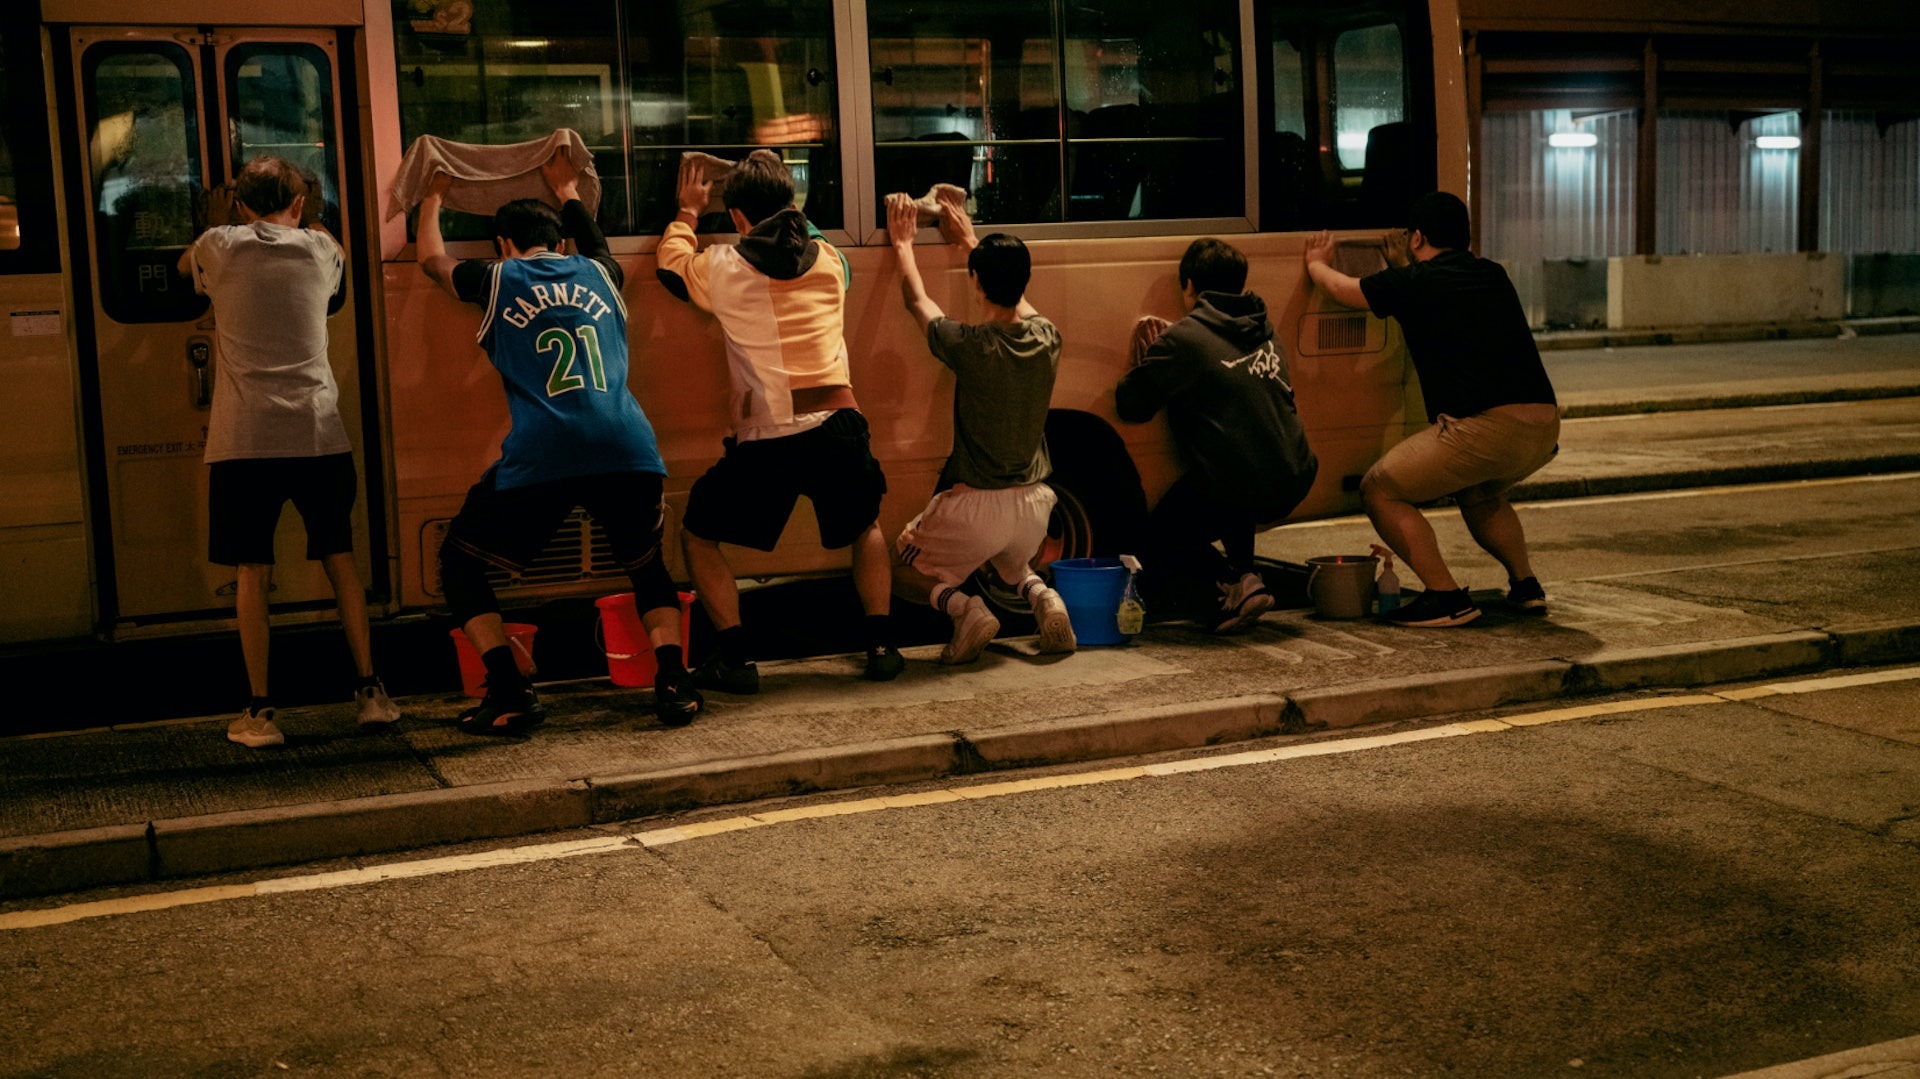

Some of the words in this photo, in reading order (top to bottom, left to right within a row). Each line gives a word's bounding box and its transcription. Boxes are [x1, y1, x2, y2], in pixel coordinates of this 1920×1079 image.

[503, 283, 611, 328] GARNETT
[536, 325, 607, 397] 21
[117, 442, 163, 455] EMERGENCY
[166, 441, 182, 453] EXIT
